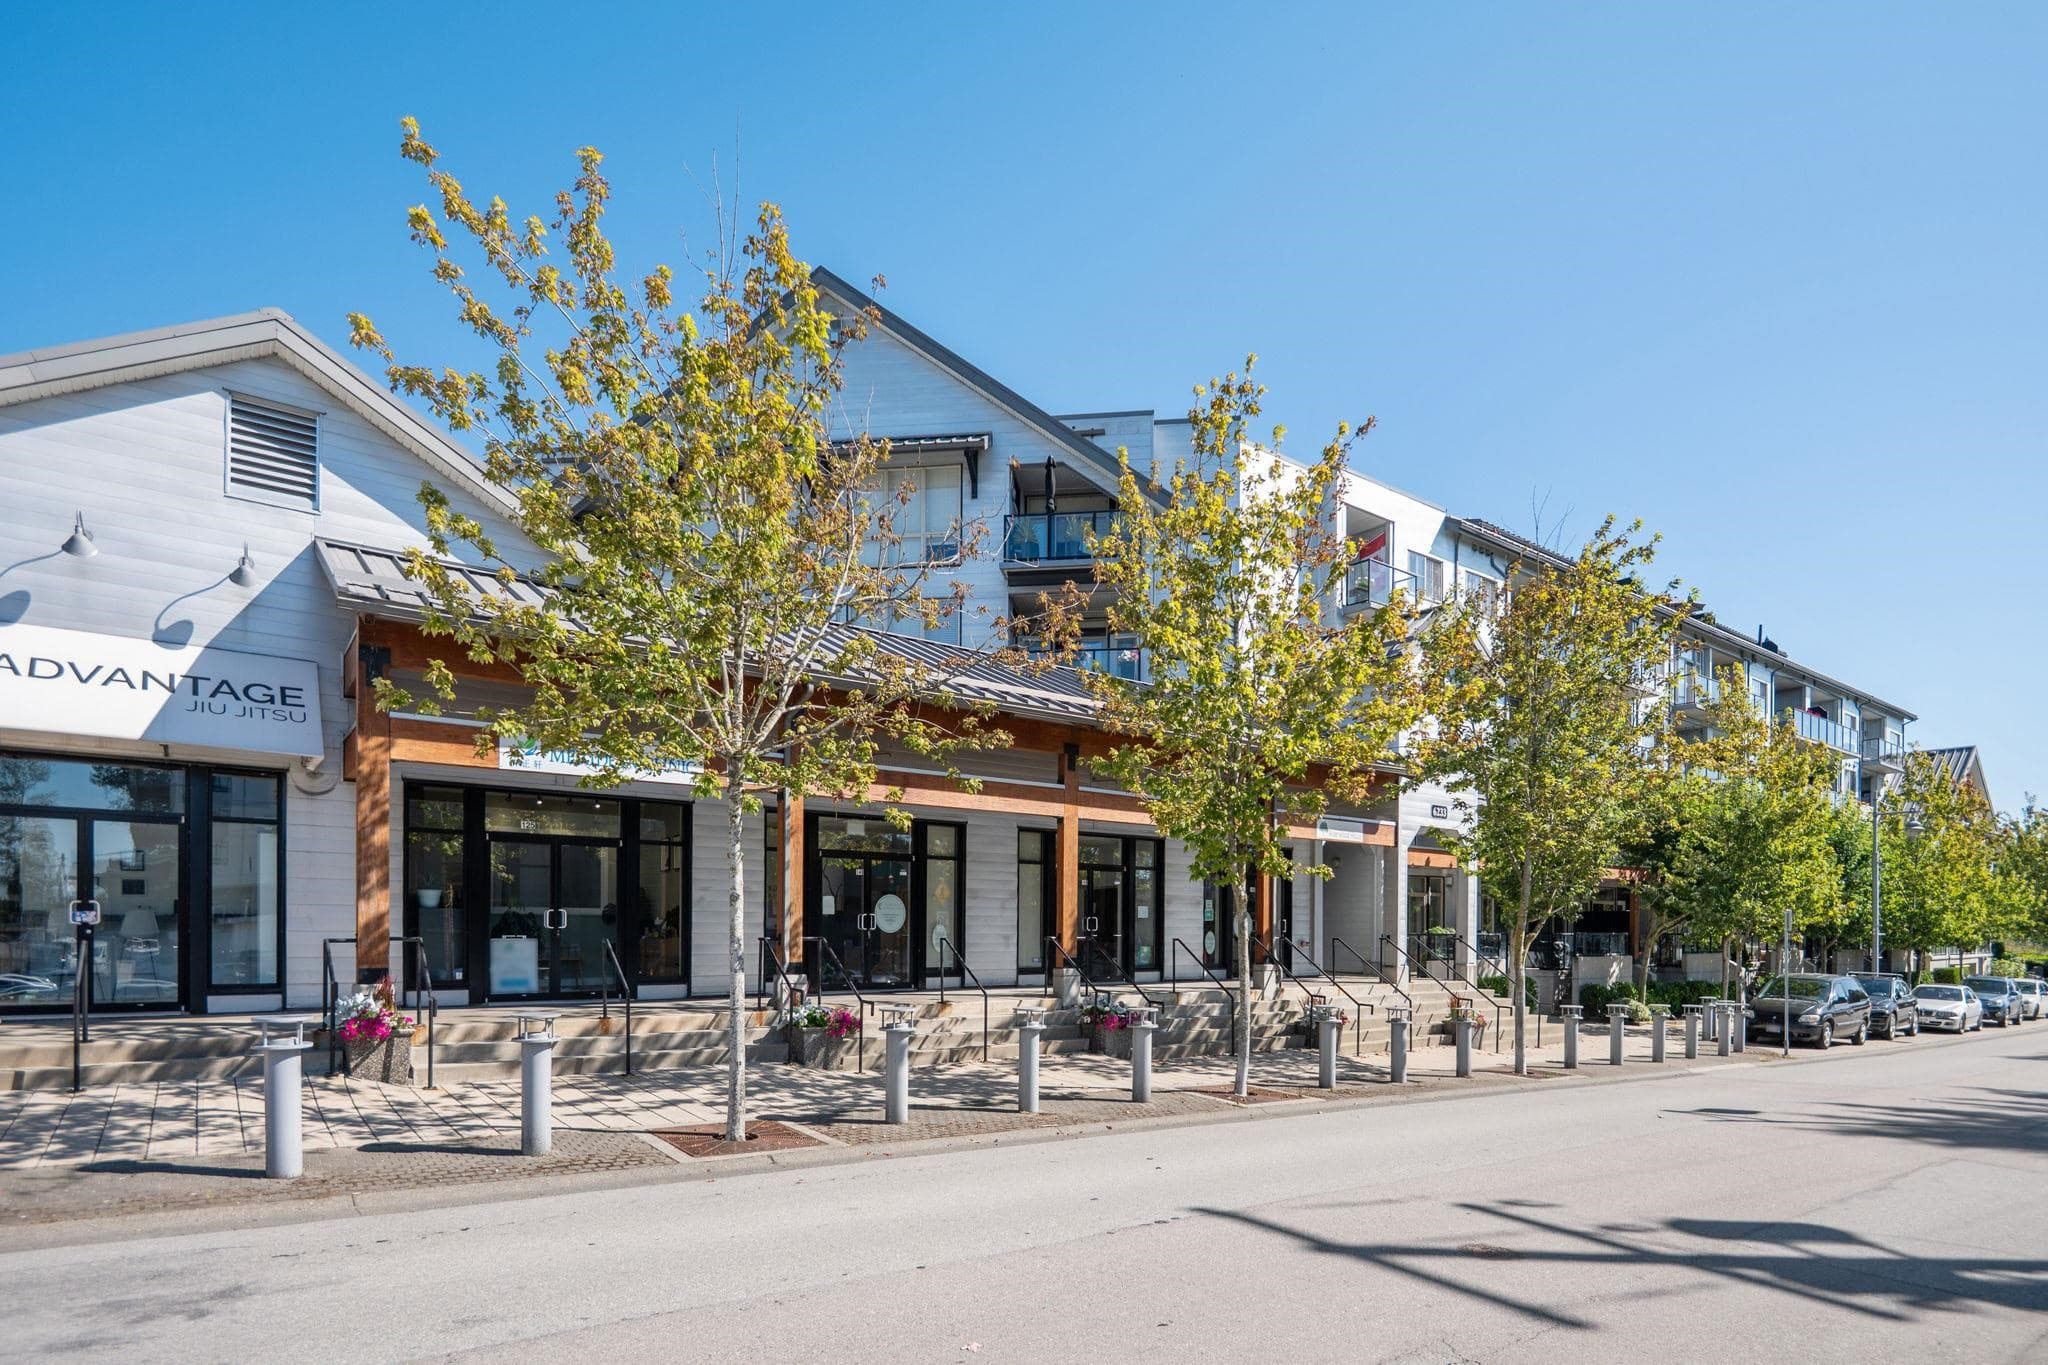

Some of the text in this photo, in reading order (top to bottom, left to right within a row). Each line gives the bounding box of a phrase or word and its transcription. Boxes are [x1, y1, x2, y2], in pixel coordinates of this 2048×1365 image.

[0, 653, 306, 708] ADVANTAGE
[185, 700, 308, 724] JIU JITSU
